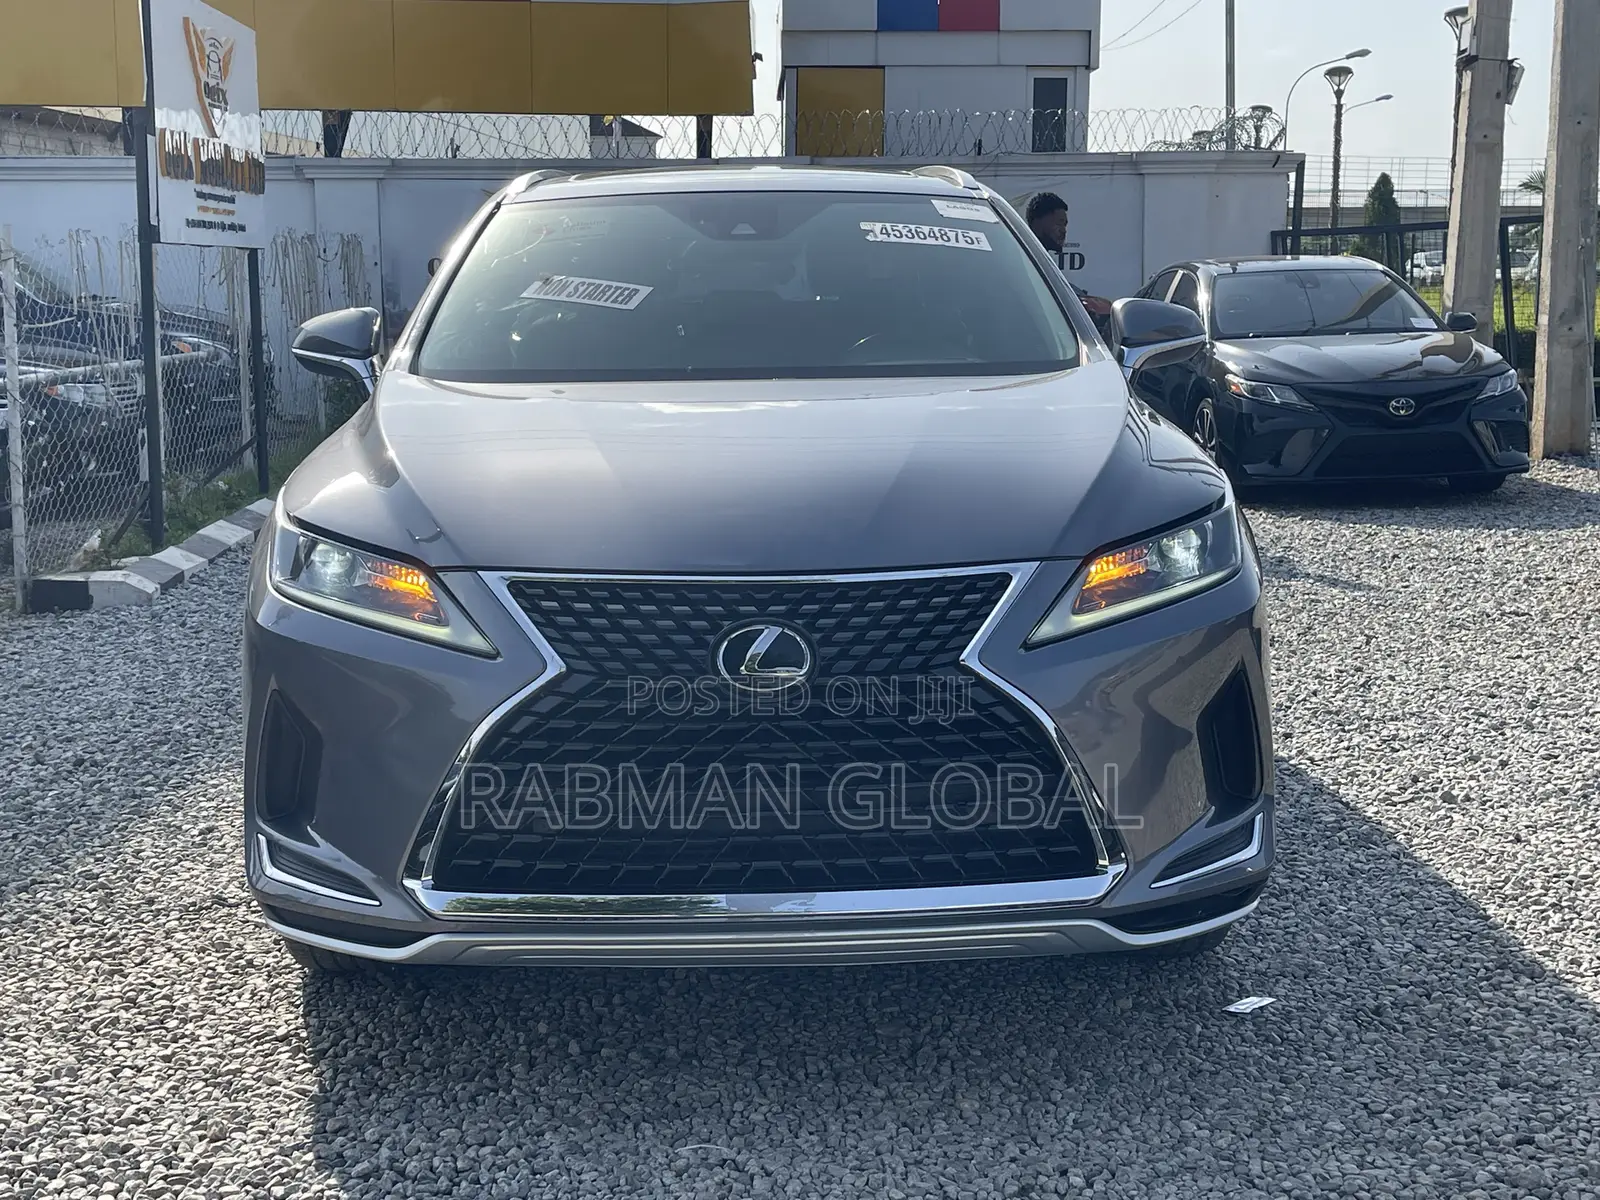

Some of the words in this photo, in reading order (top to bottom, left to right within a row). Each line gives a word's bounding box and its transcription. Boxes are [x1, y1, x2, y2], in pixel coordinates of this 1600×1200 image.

[1054, 252, 1085, 270] TD
[532, 277, 573, 297] NON
[565, 281, 640, 306] STARTER
